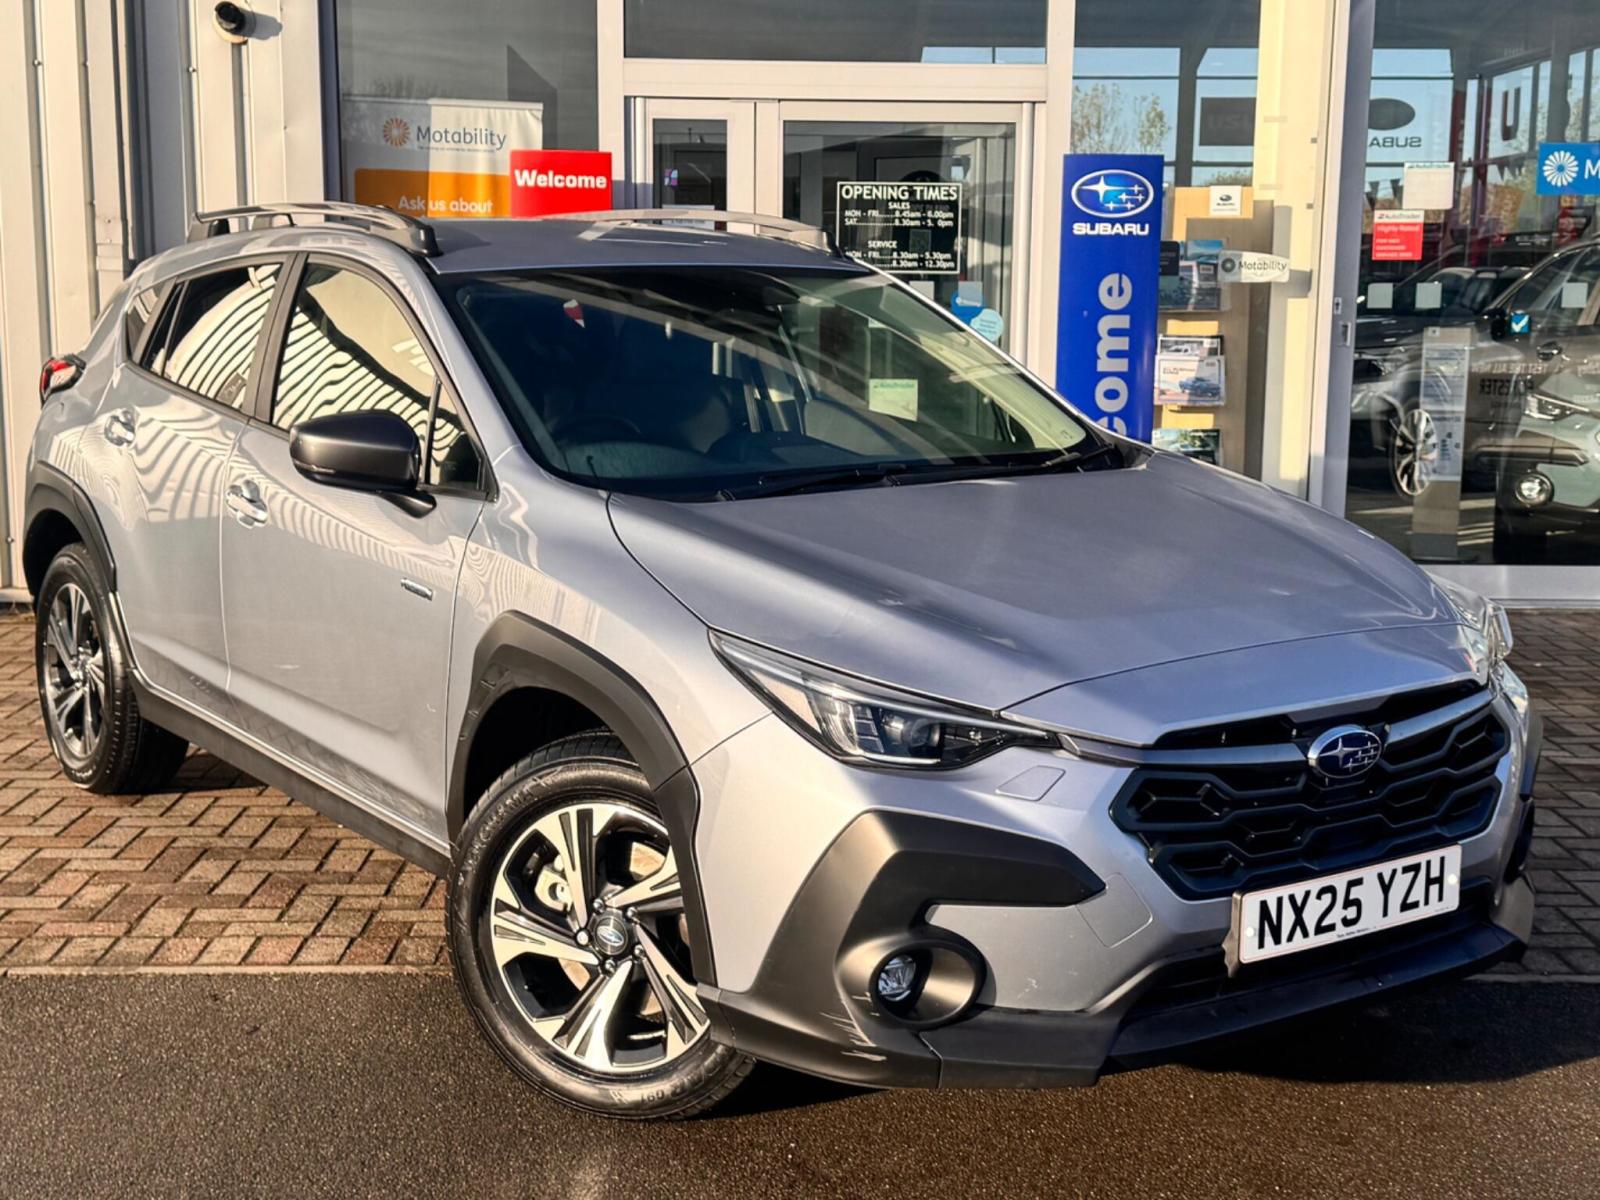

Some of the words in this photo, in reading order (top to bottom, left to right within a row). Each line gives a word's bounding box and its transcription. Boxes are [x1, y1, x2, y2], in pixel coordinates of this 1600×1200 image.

[417, 126, 507, 151] Motability
[514, 169, 607, 189] Welcome
[841, 185, 909, 200] OPENING
[913, 186, 958, 201] TIMES
[398, 195, 425, 211] Ask
[428, 200, 447, 211] us
[450, 197, 493, 213] about
[888, 201, 911, 209] SALES
[1072, 223, 1149, 236] SUBARU
[867, 240, 898, 249] SERVICE
[1238, 260, 1287, 272] Motability
[1258, 877, 1364, 950] NX25
[1377, 856, 1446, 919] YZH
